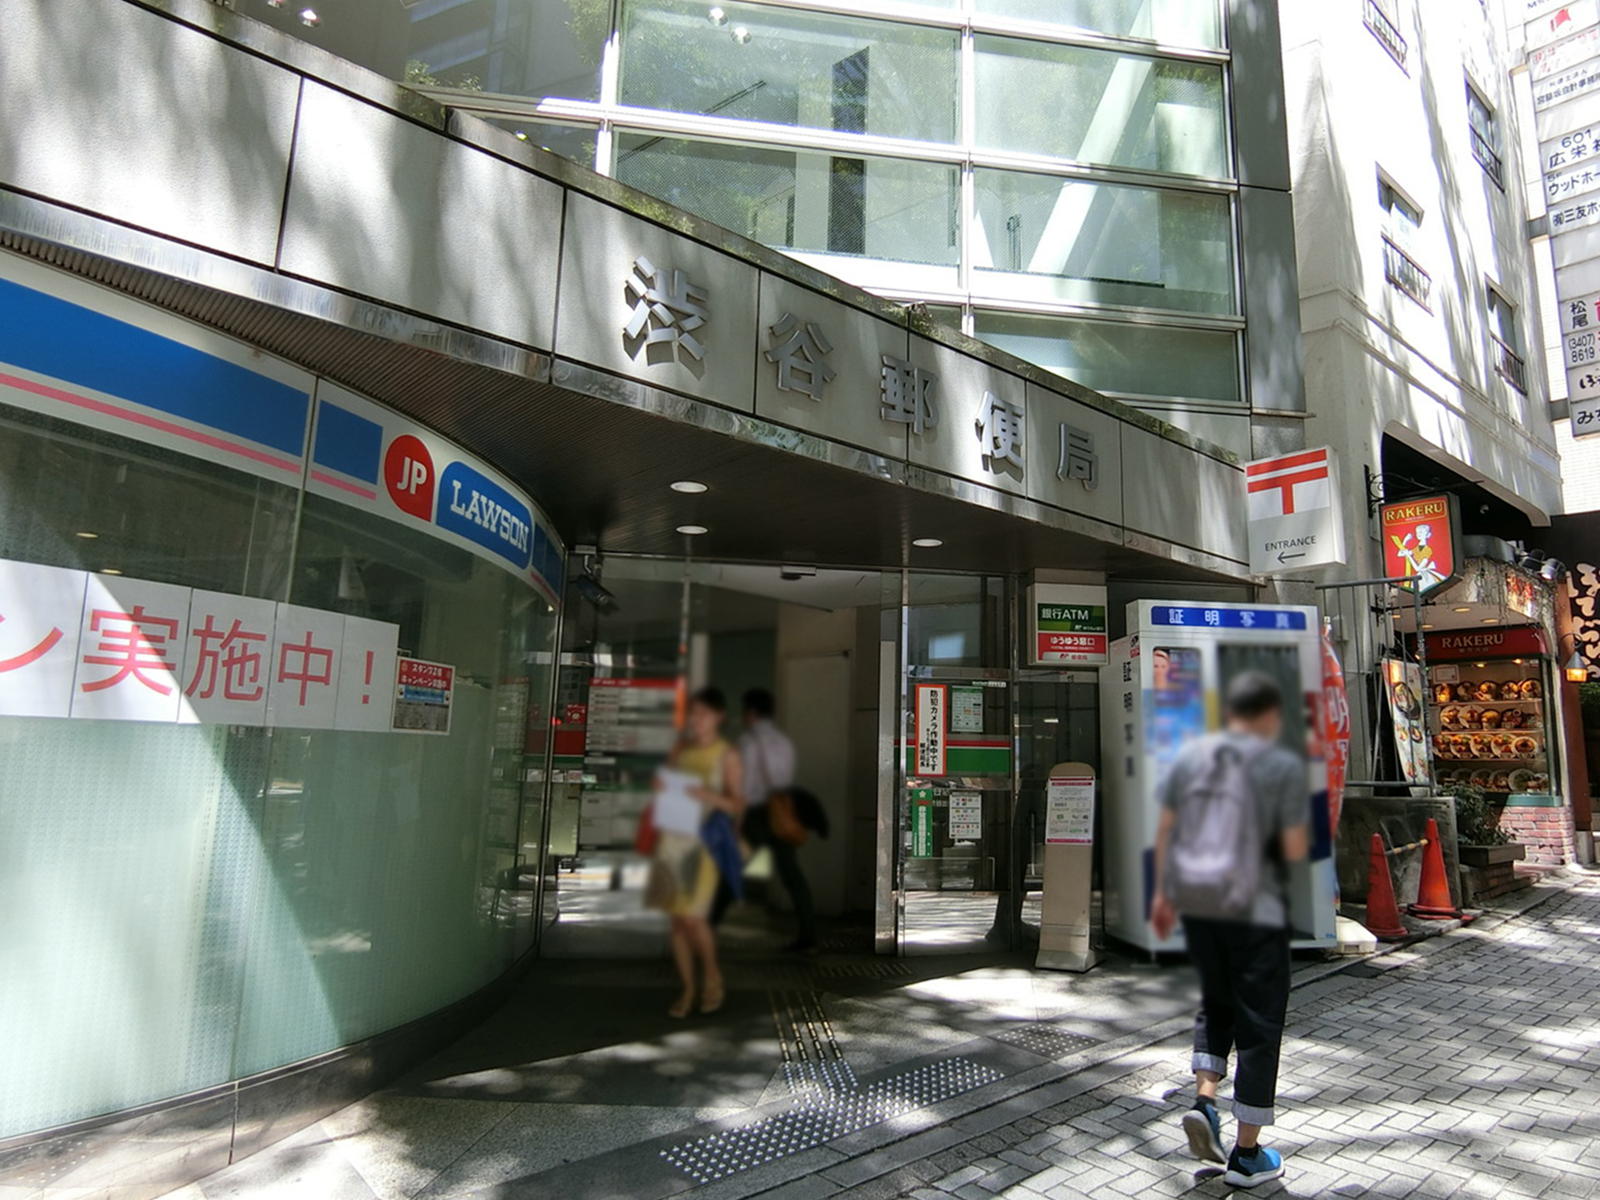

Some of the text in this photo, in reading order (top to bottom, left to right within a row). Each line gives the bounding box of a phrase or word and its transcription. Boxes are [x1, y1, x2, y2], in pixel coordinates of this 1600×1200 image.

[1562, 128, 1591, 149] 601
[1570, 300, 1589, 330] 松尾
[1568, 333, 1596, 351] (3407)
[1571, 346, 1596, 363] 8619
[624, 256, 1099, 491] 渋谷郵便局
[397, 457, 427, 495] JP
[450, 480, 529, 554] LAWSON
[1386, 502, 1443, 521] RAKERU
[1265, 535, 1316, 551] ENTRANCE
[1041, 608, 1089, 620] 銀行ATM
[1441, 634, 1504, 648] RAKERU
